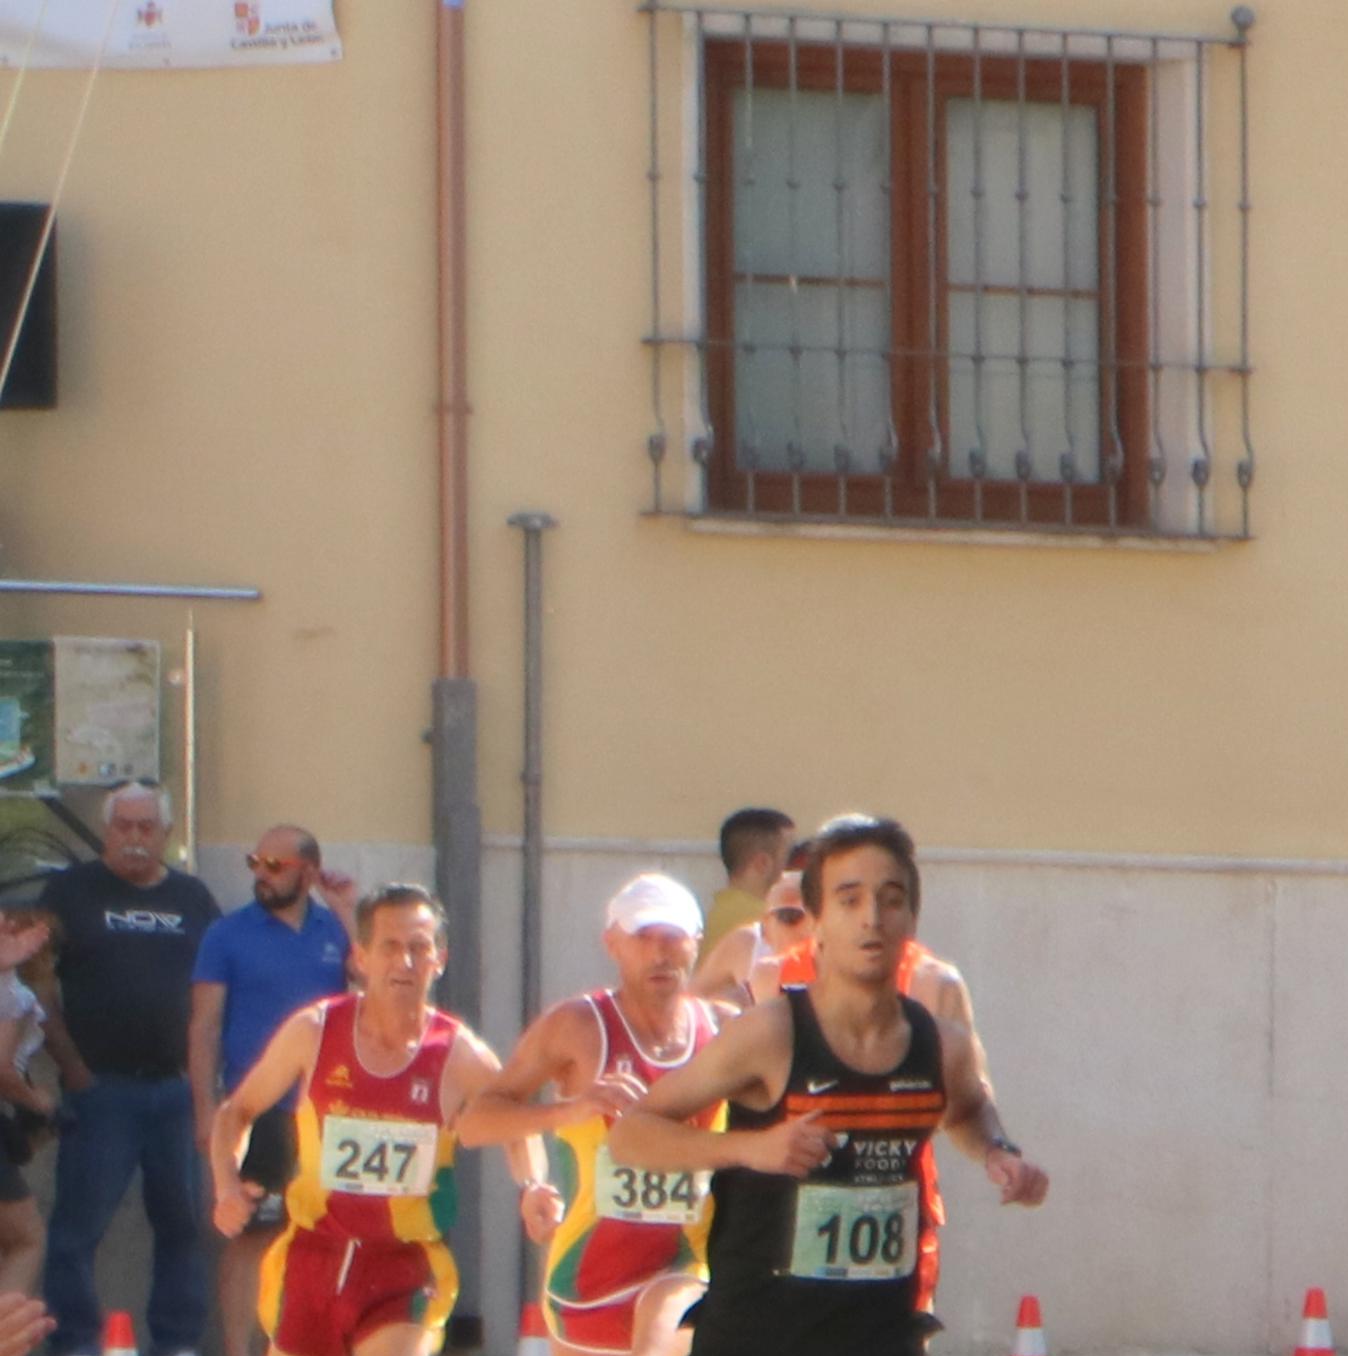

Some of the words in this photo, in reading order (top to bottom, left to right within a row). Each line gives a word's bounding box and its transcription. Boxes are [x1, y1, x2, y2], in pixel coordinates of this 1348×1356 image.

[335, 1138, 418, 1183] 247
[853, 1141, 917, 1156] VICKY
[612, 1168, 695, 1210] 384
[817, 1213, 905, 1266] 108
